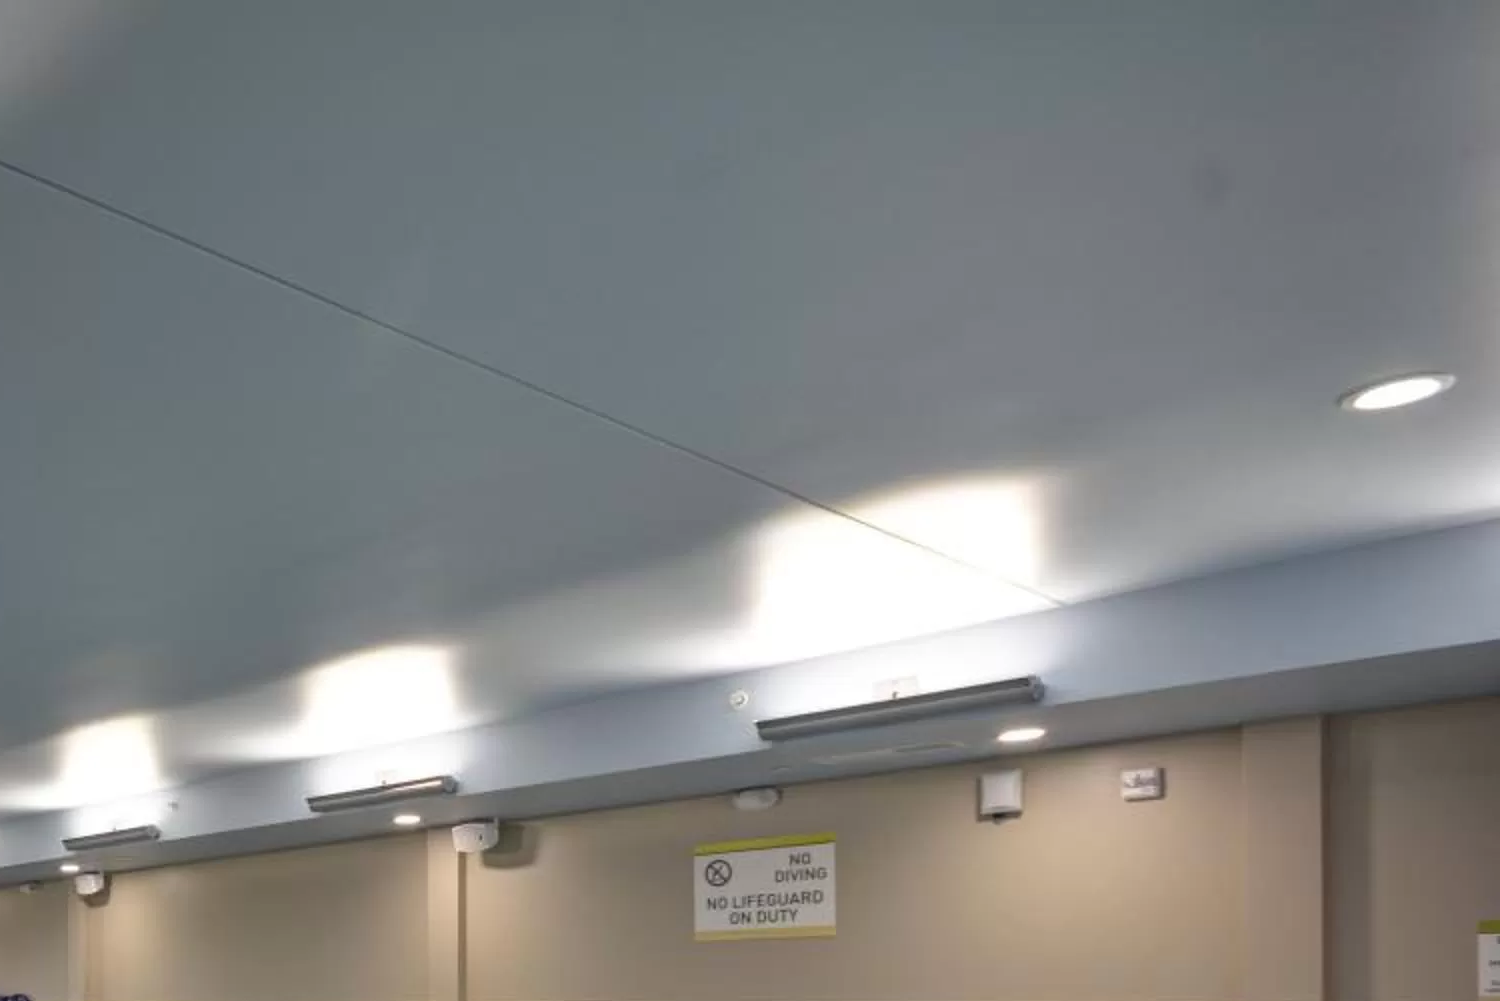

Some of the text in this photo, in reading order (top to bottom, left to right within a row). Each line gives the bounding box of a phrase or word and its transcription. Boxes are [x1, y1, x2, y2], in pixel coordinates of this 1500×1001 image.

[788, 852, 812, 865] NO
[775, 867, 828, 883] DIVING
[706, 890, 824, 910] NO LIFEGUARD
[728, 909, 799, 925] ON DUTY
